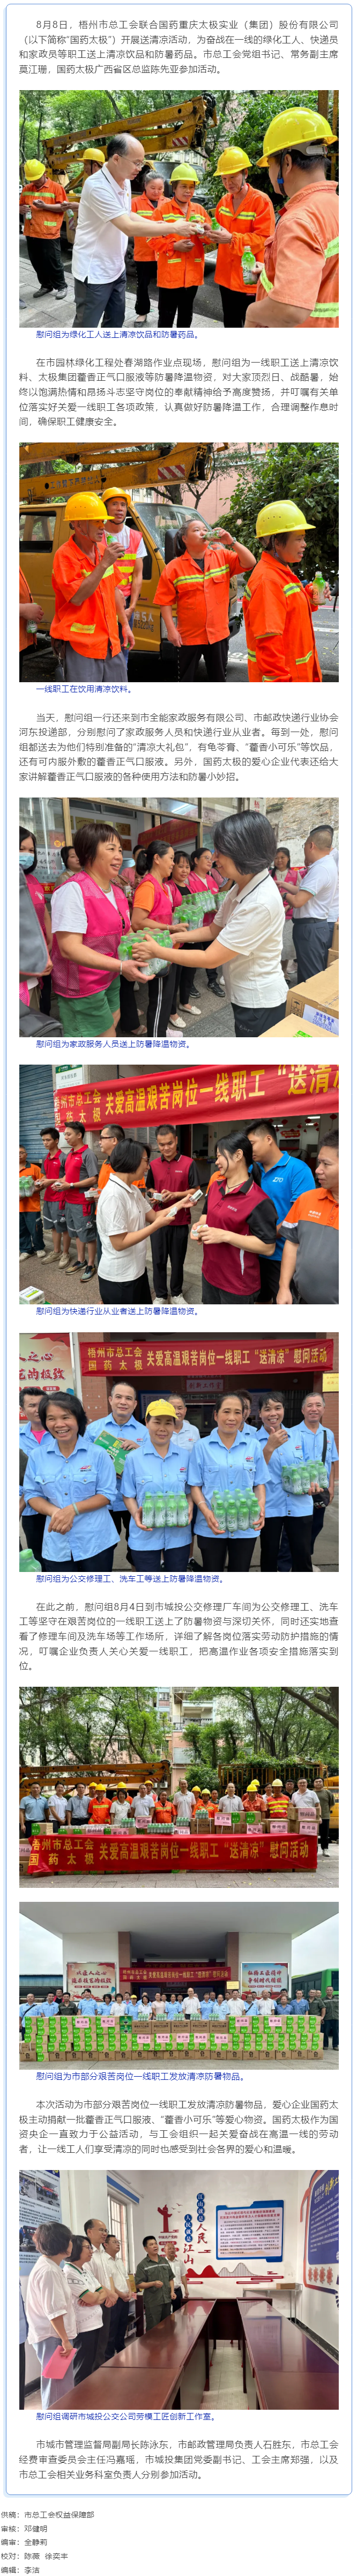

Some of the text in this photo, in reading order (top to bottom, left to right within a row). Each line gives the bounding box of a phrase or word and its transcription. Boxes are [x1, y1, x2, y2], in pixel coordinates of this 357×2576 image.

[36, 20, 338, 29] 8月8日，梧州市总工会联合国药重庆太极实业（集团）股份有限公司
[19, 49, 338, 59] 和家政员等职工送上清凉饮品和防暑药品。市总工会党组书记、常务副主席
[19, 64, 219, 74] 莫江珊，国药太极广西省区总监陈先亚参加活动。
[36, 358, 338, 367] 在市园林绿化工程处春湖路作业点现场，慰问组为一线职工送上清凉饮
[19, 372, 338, 382] 料、太极集团藿香正气口服液等防暑降温物资，对大家顶烈日、战酷暑，始
[19, 387, 338, 397] 终以饱满热情和昂扬斗志坚守岗位的奉献精神给予高度赞扬，并叮嘱有关单
[19, 402, 338, 412] 位落实好关爱一线职工各项政策，认真做好防暑降温工作，合理调整作息时
[19, 417, 116, 426] 间，确保职工健康安全。
[37, 713, 338, 722] 当天，慰问组一行还来到市全能家政服务有限公司、市邮政快递行业协会
[19, 727, 338, 737] 河东投递部，分别慰问了家政服务人员和快递行业从业者。每到一处，慰问
[19, 757, 338, 766] 还有可内服外敷的藿香正气口服液。另外，国药太极的爱心企业代表还给大
[19, 772, 239, 781] 家讲解藿香正气口服液的各种使用方法和防暑小妙招。
[87, 1347, 143, 1358] 梧州市总工会
[88, 1360, 143, 1371] 国药太极
[36, 1602, 338, 1612] 在此之前，慰问组8月4日到市城投公交修理厂车间为公交修理工、洗车
[19, 1617, 338, 1626] 工等坚守在艰苦岗位的一线职工送上了防暑物资与深切关怀，同时还实地查
[19, 1632, 338, 1641] 看了修理车间及洗车场等工作场所，详细了解各岗位落实劳动防护措施的情
[19, 1647, 338, 1656] 况，叮嘱企业负责人关心关爱一线职工，把高温作业各项安全措施落实到
[19, 1662, 32, 1671] 位。
[36, 2100, 338, 2110] 本次活动为市部分艰苦岗位一线职工发放清凉防暑物品，爱心企业国药太
[19, 2129, 338, 2139] 资央企一直致力于公益活动，与工会组织一起关爱奋战在高温一线的劳动
[19, 2144, 295, 2154] 者，让一线工人们享受清凉的同时也感受到社会各界的爱心和温暖。
[36, 2440, 339, 2449] 市城市管理监督局副局长陈泳东，市邮政管理局负责人石胜东，市总工会
[19, 2455, 338, 2464] 经费审查委员会主任冯嘉瑶，市城投集团党委副书记、工会主席郑强，以及
[19, 2470, 202, 2479] 市总工会相关业务科室负责人分别参加活动。
